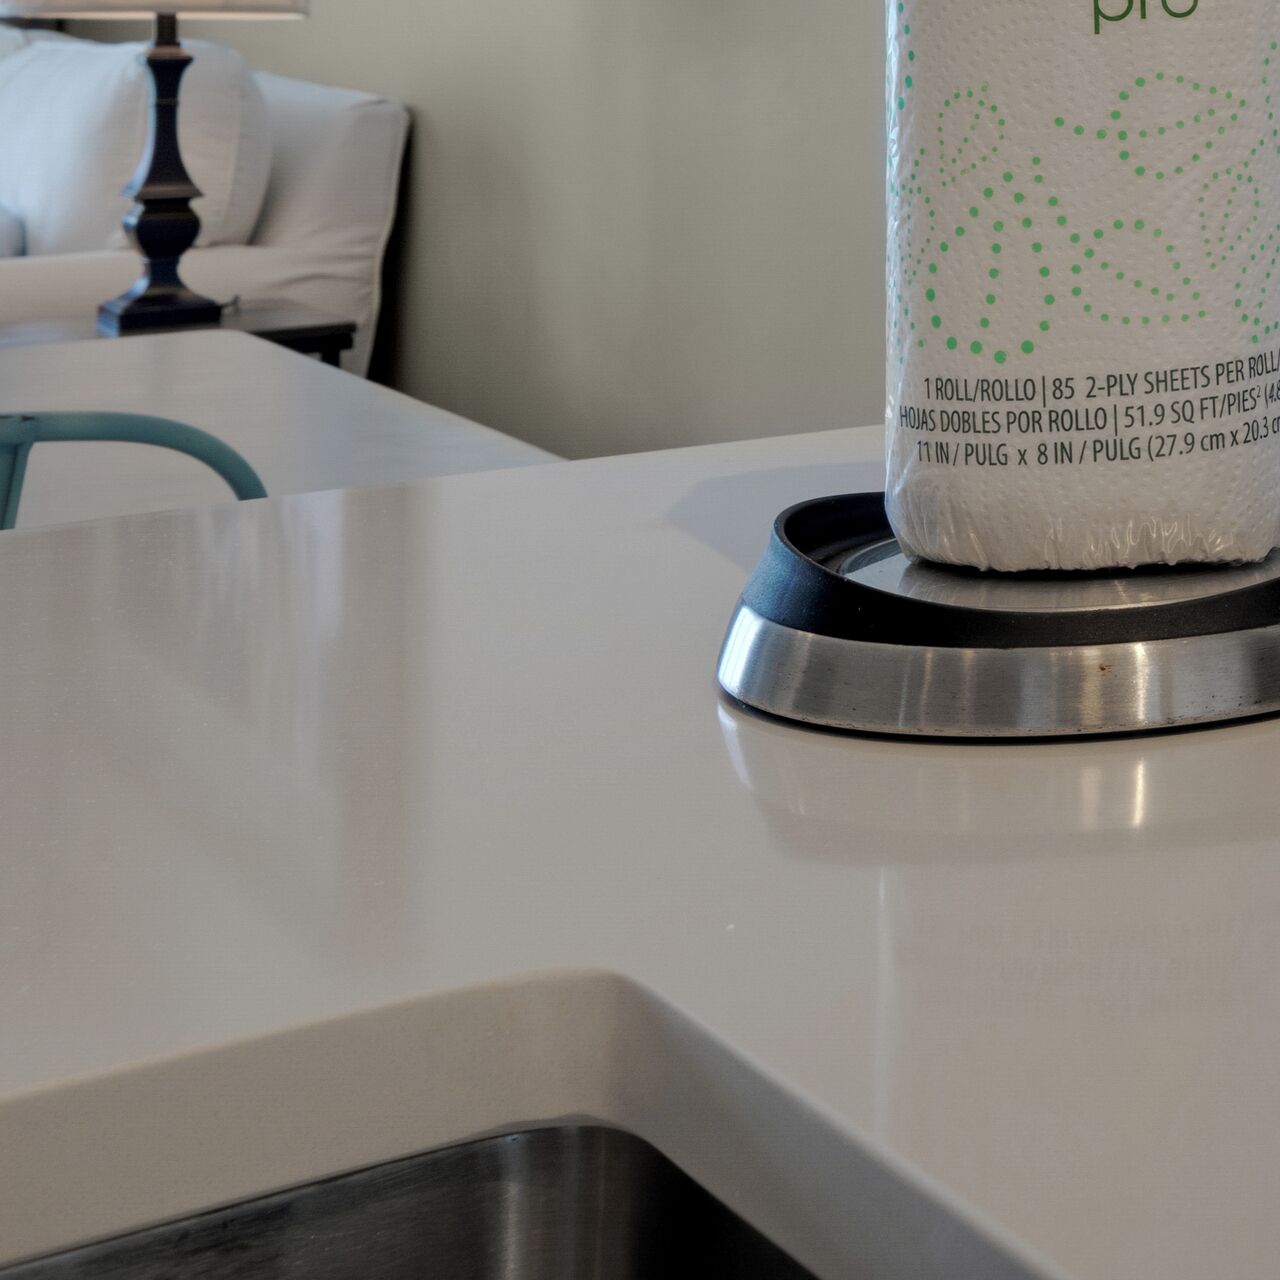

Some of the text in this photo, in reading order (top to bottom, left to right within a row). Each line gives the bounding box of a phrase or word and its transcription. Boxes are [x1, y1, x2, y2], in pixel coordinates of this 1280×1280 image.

[924, 377, 931, 399] 1
[935, 377, 1036, 402] ROLL/ROLLO
[1052, 377, 1075, 400] 85
[1086, 372, 1138, 398] 2-PLY
[1144, 365, 1211, 394] SHEETS
[1216, 359, 1245, 386] PER
[900, 406, 936, 431] HOJAS
[940, 409, 1001, 433] DOBLES
[1007, 410, 1043, 433] POR
[1048, 407, 1107, 432] ROLLO
[1124, 403, 1165, 428] 51.9
[1171, 400, 1195, 424] SQ
[917, 440, 931, 462] 11
[964, 443, 1008, 465] PULG
[1018, 449, 1027, 465] x
[1037, 443, 1048, 465] 8
[1054, 441, 1073, 464] IN
[1093, 436, 1141, 462] PULG
[1148, 432, 1195, 462] (27.9
[1200, 432, 1225, 451] cm
[1230, 429, 1238, 447] x
[1243, 416, 1269, 444] 20.3
